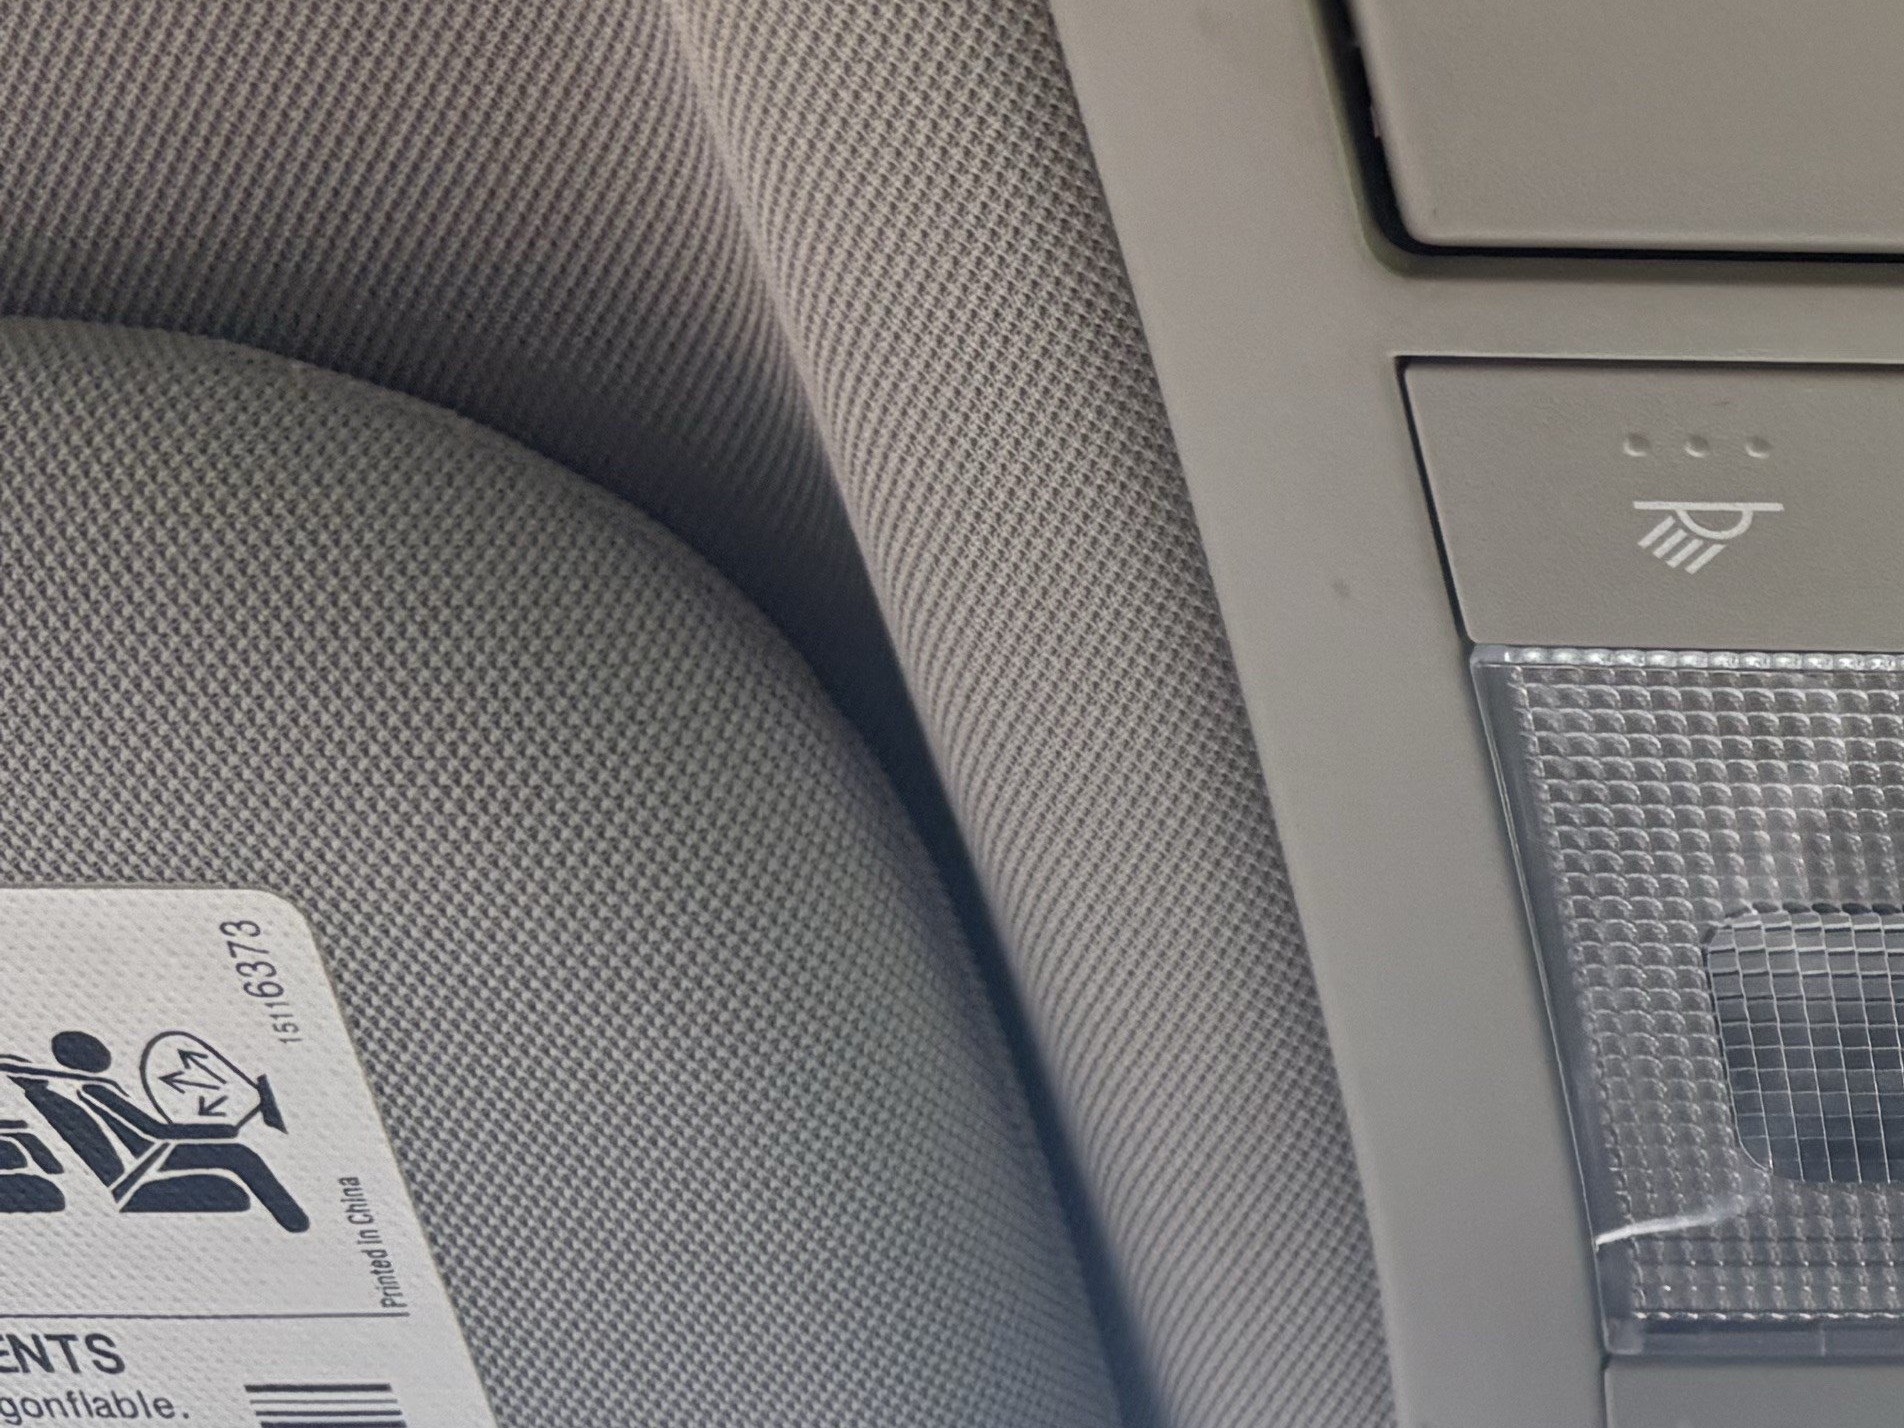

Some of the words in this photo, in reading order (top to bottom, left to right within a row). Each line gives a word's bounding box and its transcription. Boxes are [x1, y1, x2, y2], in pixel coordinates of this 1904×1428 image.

[219, 919, 302, 1045] 15116373
[338, 1176, 373, 1226] China
[361, 1249, 408, 1309] Printed
[0, 1389, 190, 1426] gonflable.
